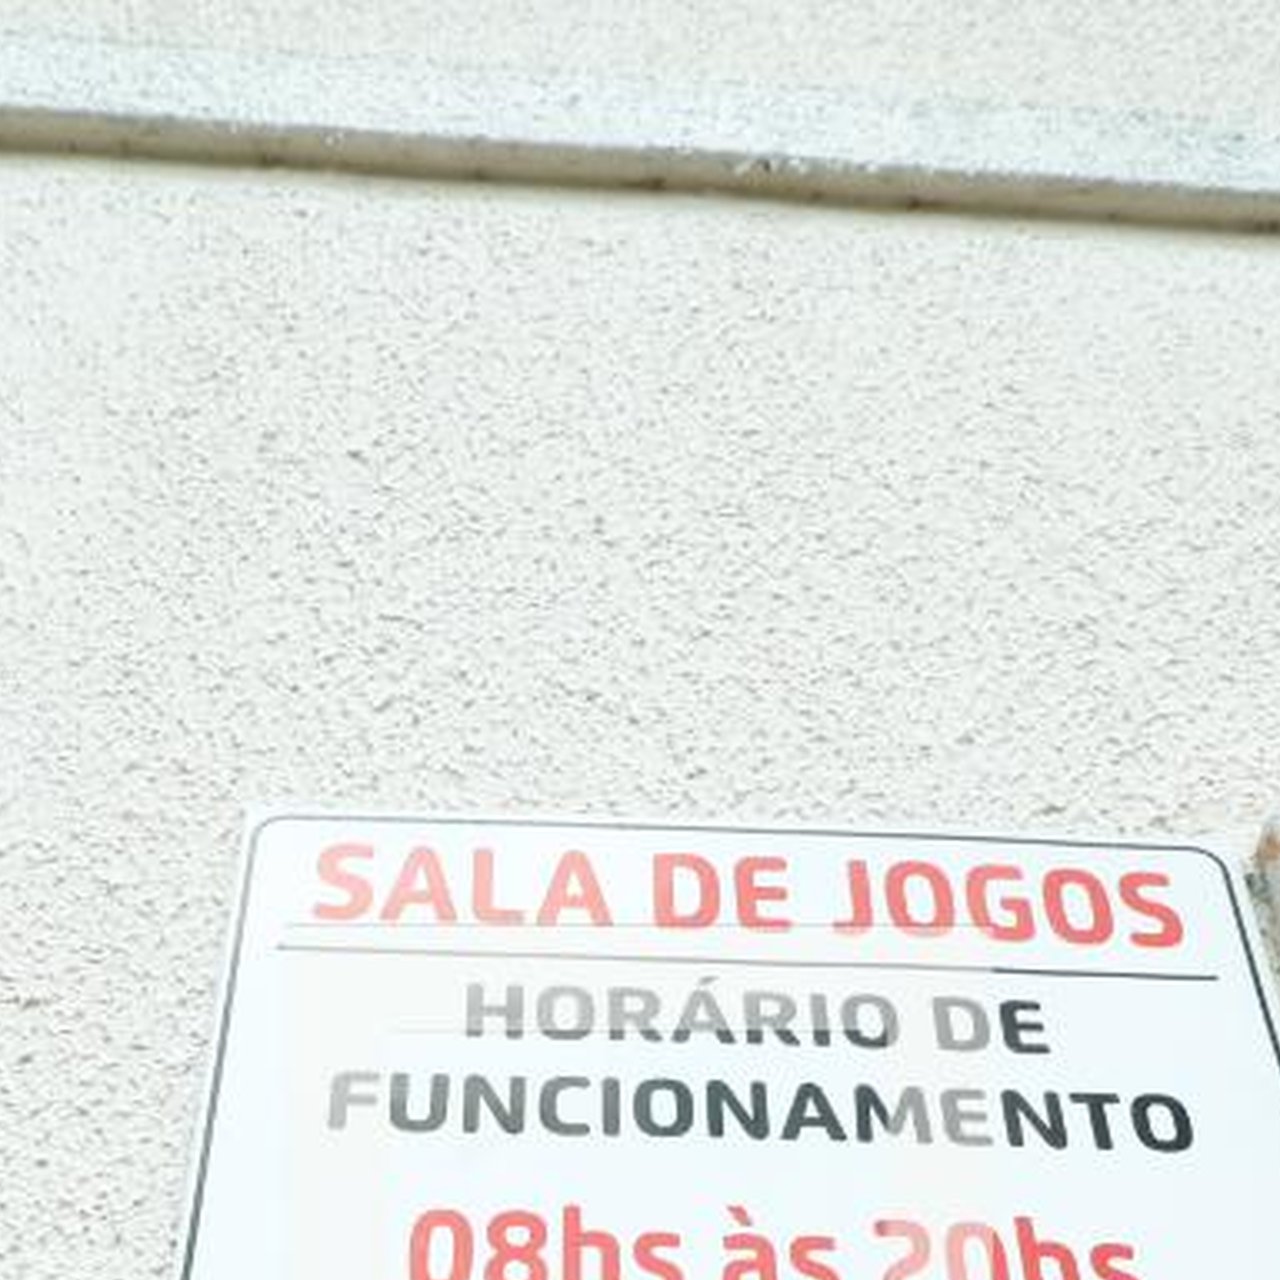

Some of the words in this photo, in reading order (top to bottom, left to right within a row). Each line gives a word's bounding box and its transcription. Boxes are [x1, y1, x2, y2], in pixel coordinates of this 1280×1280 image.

[313, 844, 614, 928] SALA
[652, 852, 794, 933] DE
[830, 859, 1185, 949] JOGOS
[465, 977, 899, 1050] HORÁRIO
[934, 996, 1051, 1056] DE
[327, 1072, 1195, 1154] FUNCIONAMENTO
